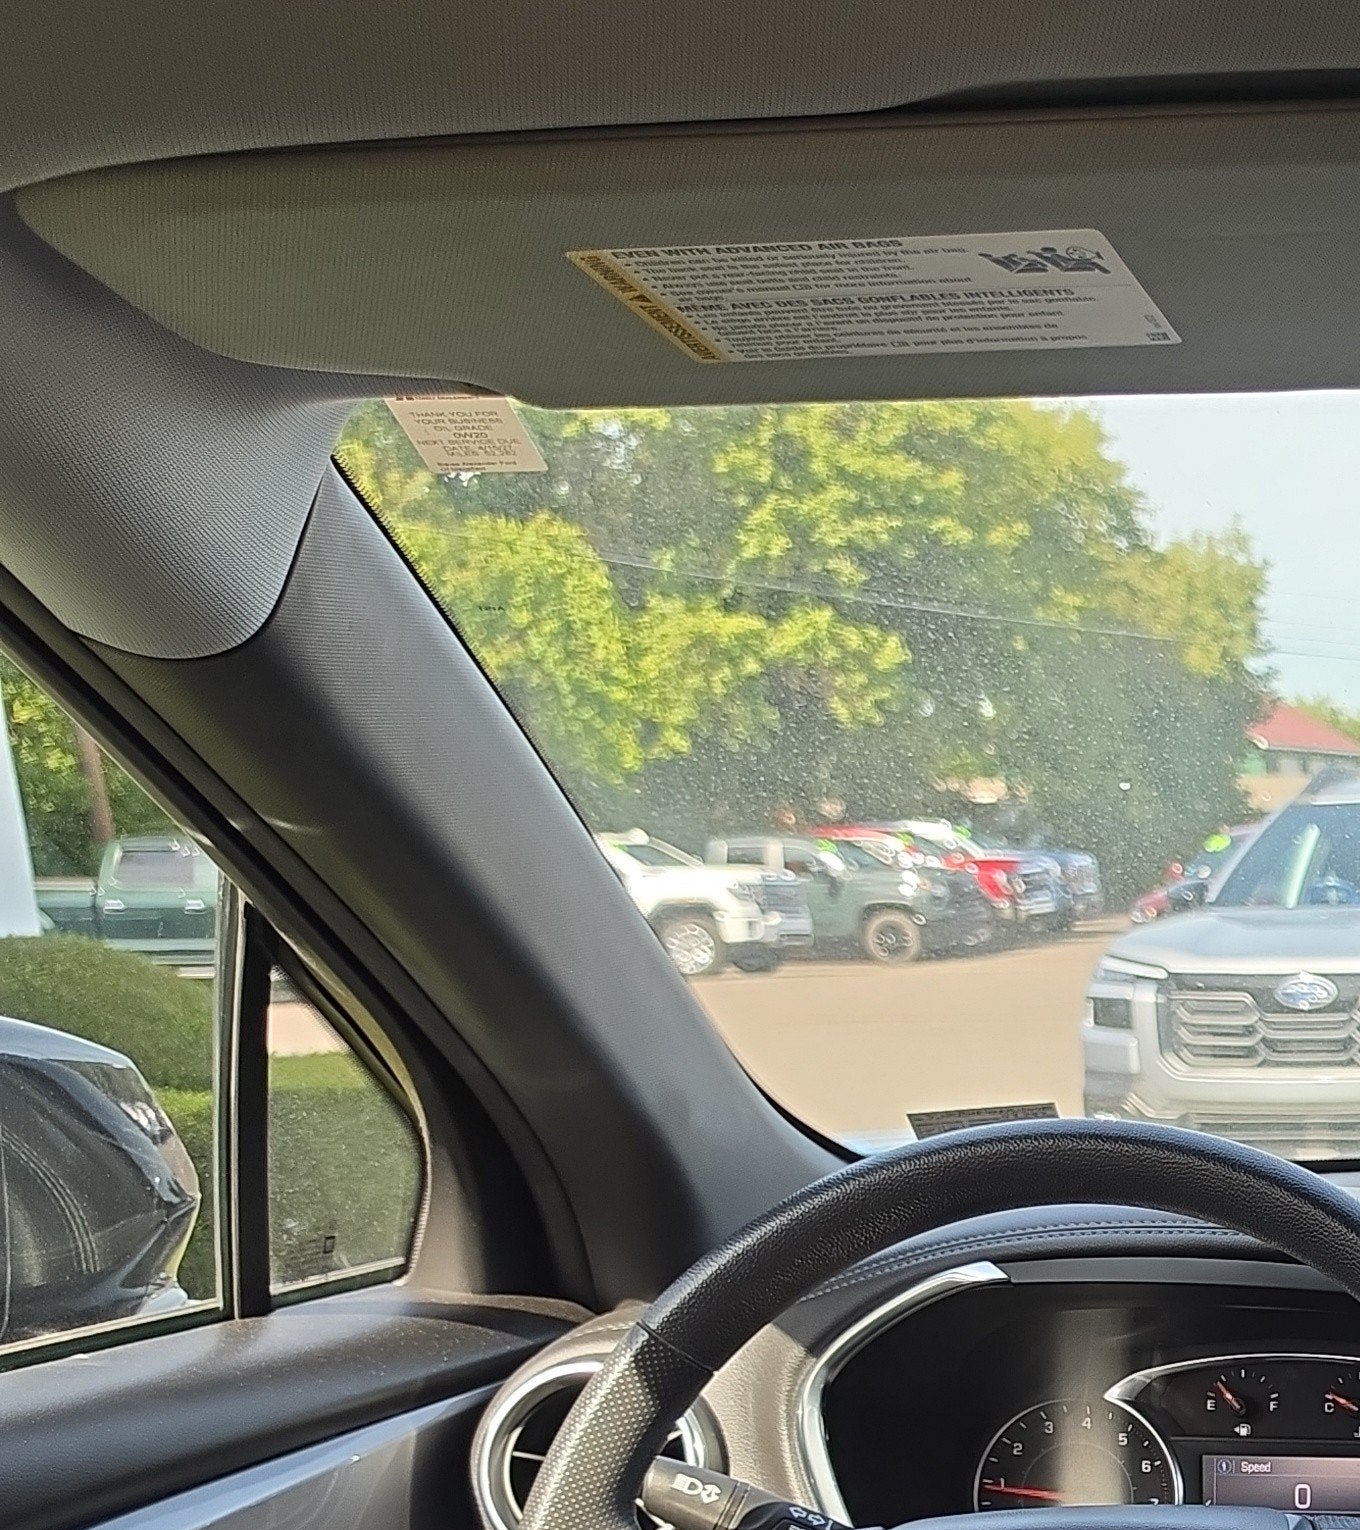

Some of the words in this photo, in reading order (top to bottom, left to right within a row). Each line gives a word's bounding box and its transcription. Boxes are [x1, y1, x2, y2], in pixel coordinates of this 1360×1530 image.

[610, 250, 660, 258] EVEN
[660, 248, 712, 256] WITH
[712, 243, 813, 254] ADVANCED
[851, 239, 903, 247] BAGS
[1207, 1400, 1216, 1410] E
[1270, 1402, 1279, 1411] F
[1325, 1403, 1334, 1413] C
[1044, 1421, 1054, 1434] 3
[1082, 1417, 1091, 1429] 4
[1118, 1433, 1128, 1445] 5
[1013, 1442, 1023, 1455] 2
[1141, 1460, 1151, 1473] 6
[1241, 1461, 1271, 1474] Speed
[1294, 1483, 1311, 1509] 0
